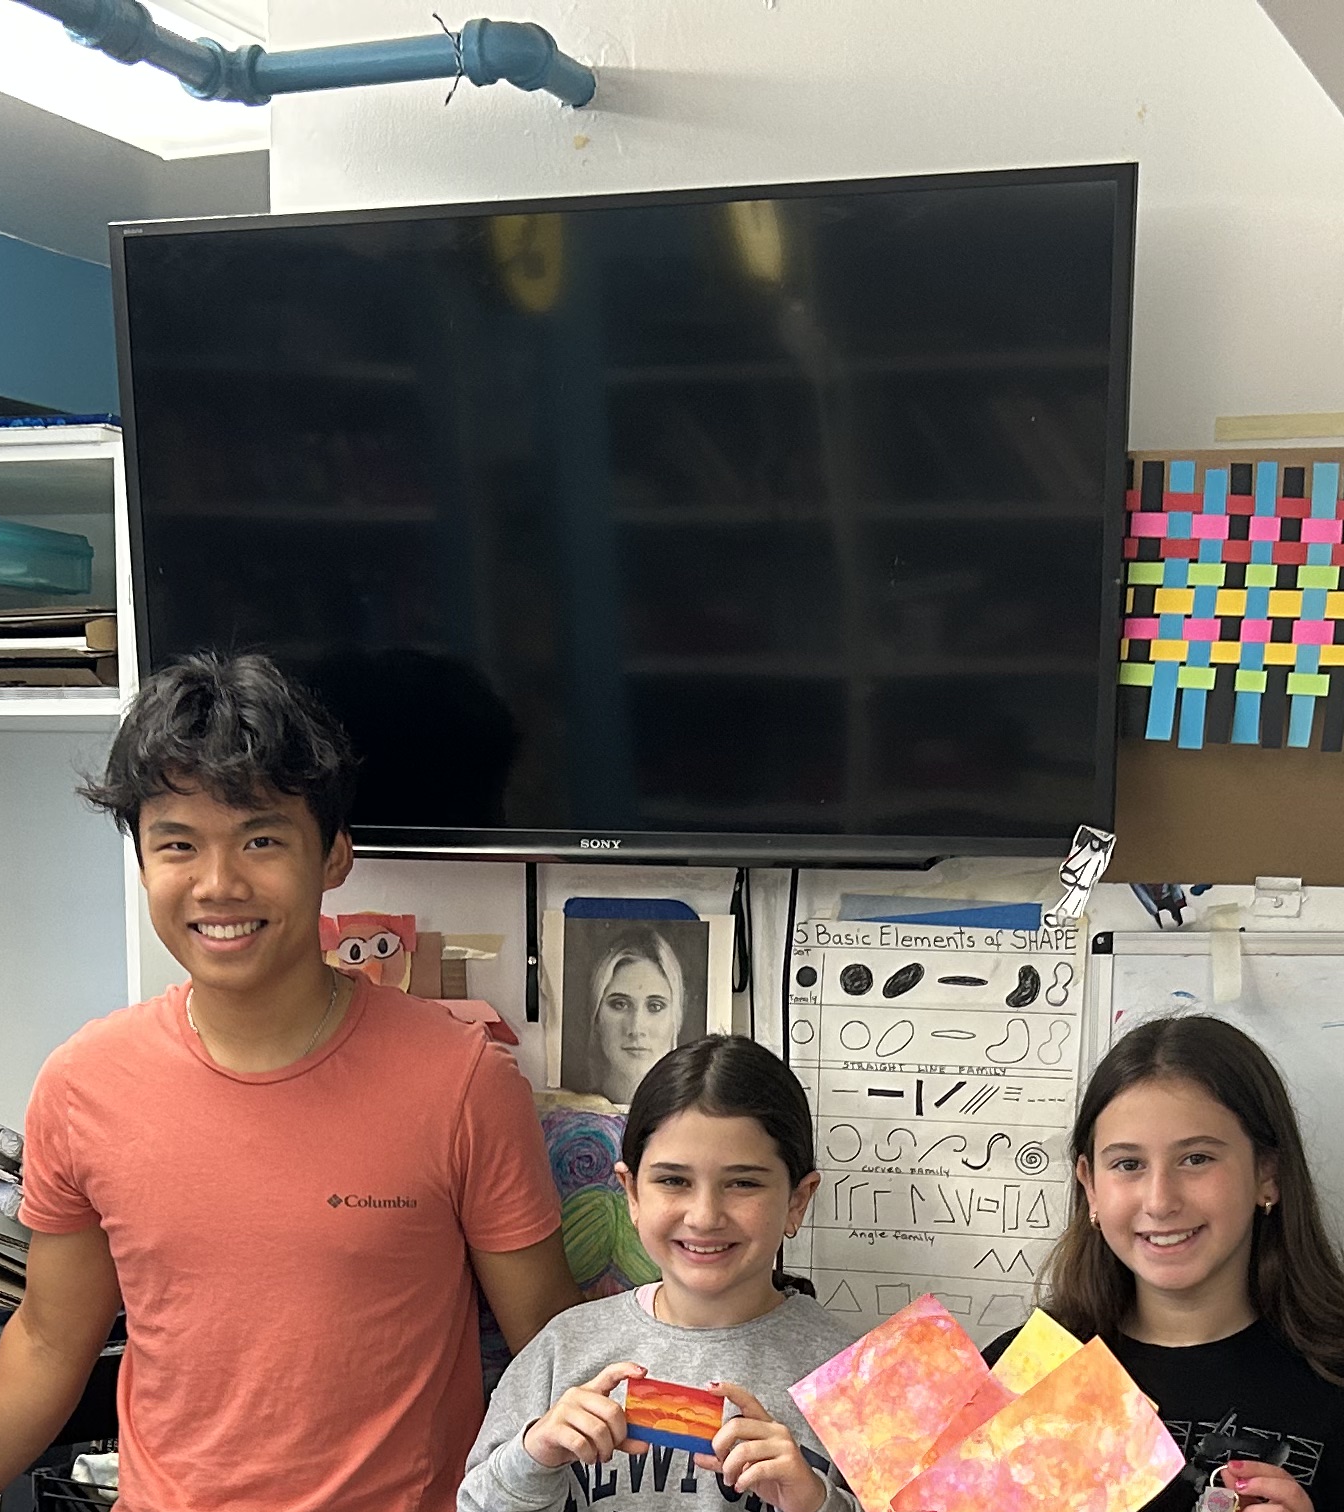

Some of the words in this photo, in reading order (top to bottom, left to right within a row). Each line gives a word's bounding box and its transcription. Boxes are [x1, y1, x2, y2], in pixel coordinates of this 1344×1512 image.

[580, 839, 622, 849] SONY
[793, 922, 809, 946] 5
[816, 924, 872, 946] Basic
[880, 924, 975, 948] Elements
[985, 928, 1004, 950] of
[1010, 928, 1079, 951] SHAPE
[842, 1061, 905, 1072] STRAIGHT
[917, 1064, 946, 1074] LINE
[344, 1194, 417, 1209] Columbia
[849, 1229, 888, 1245] Angle
[892, 1231, 935, 1247] family
